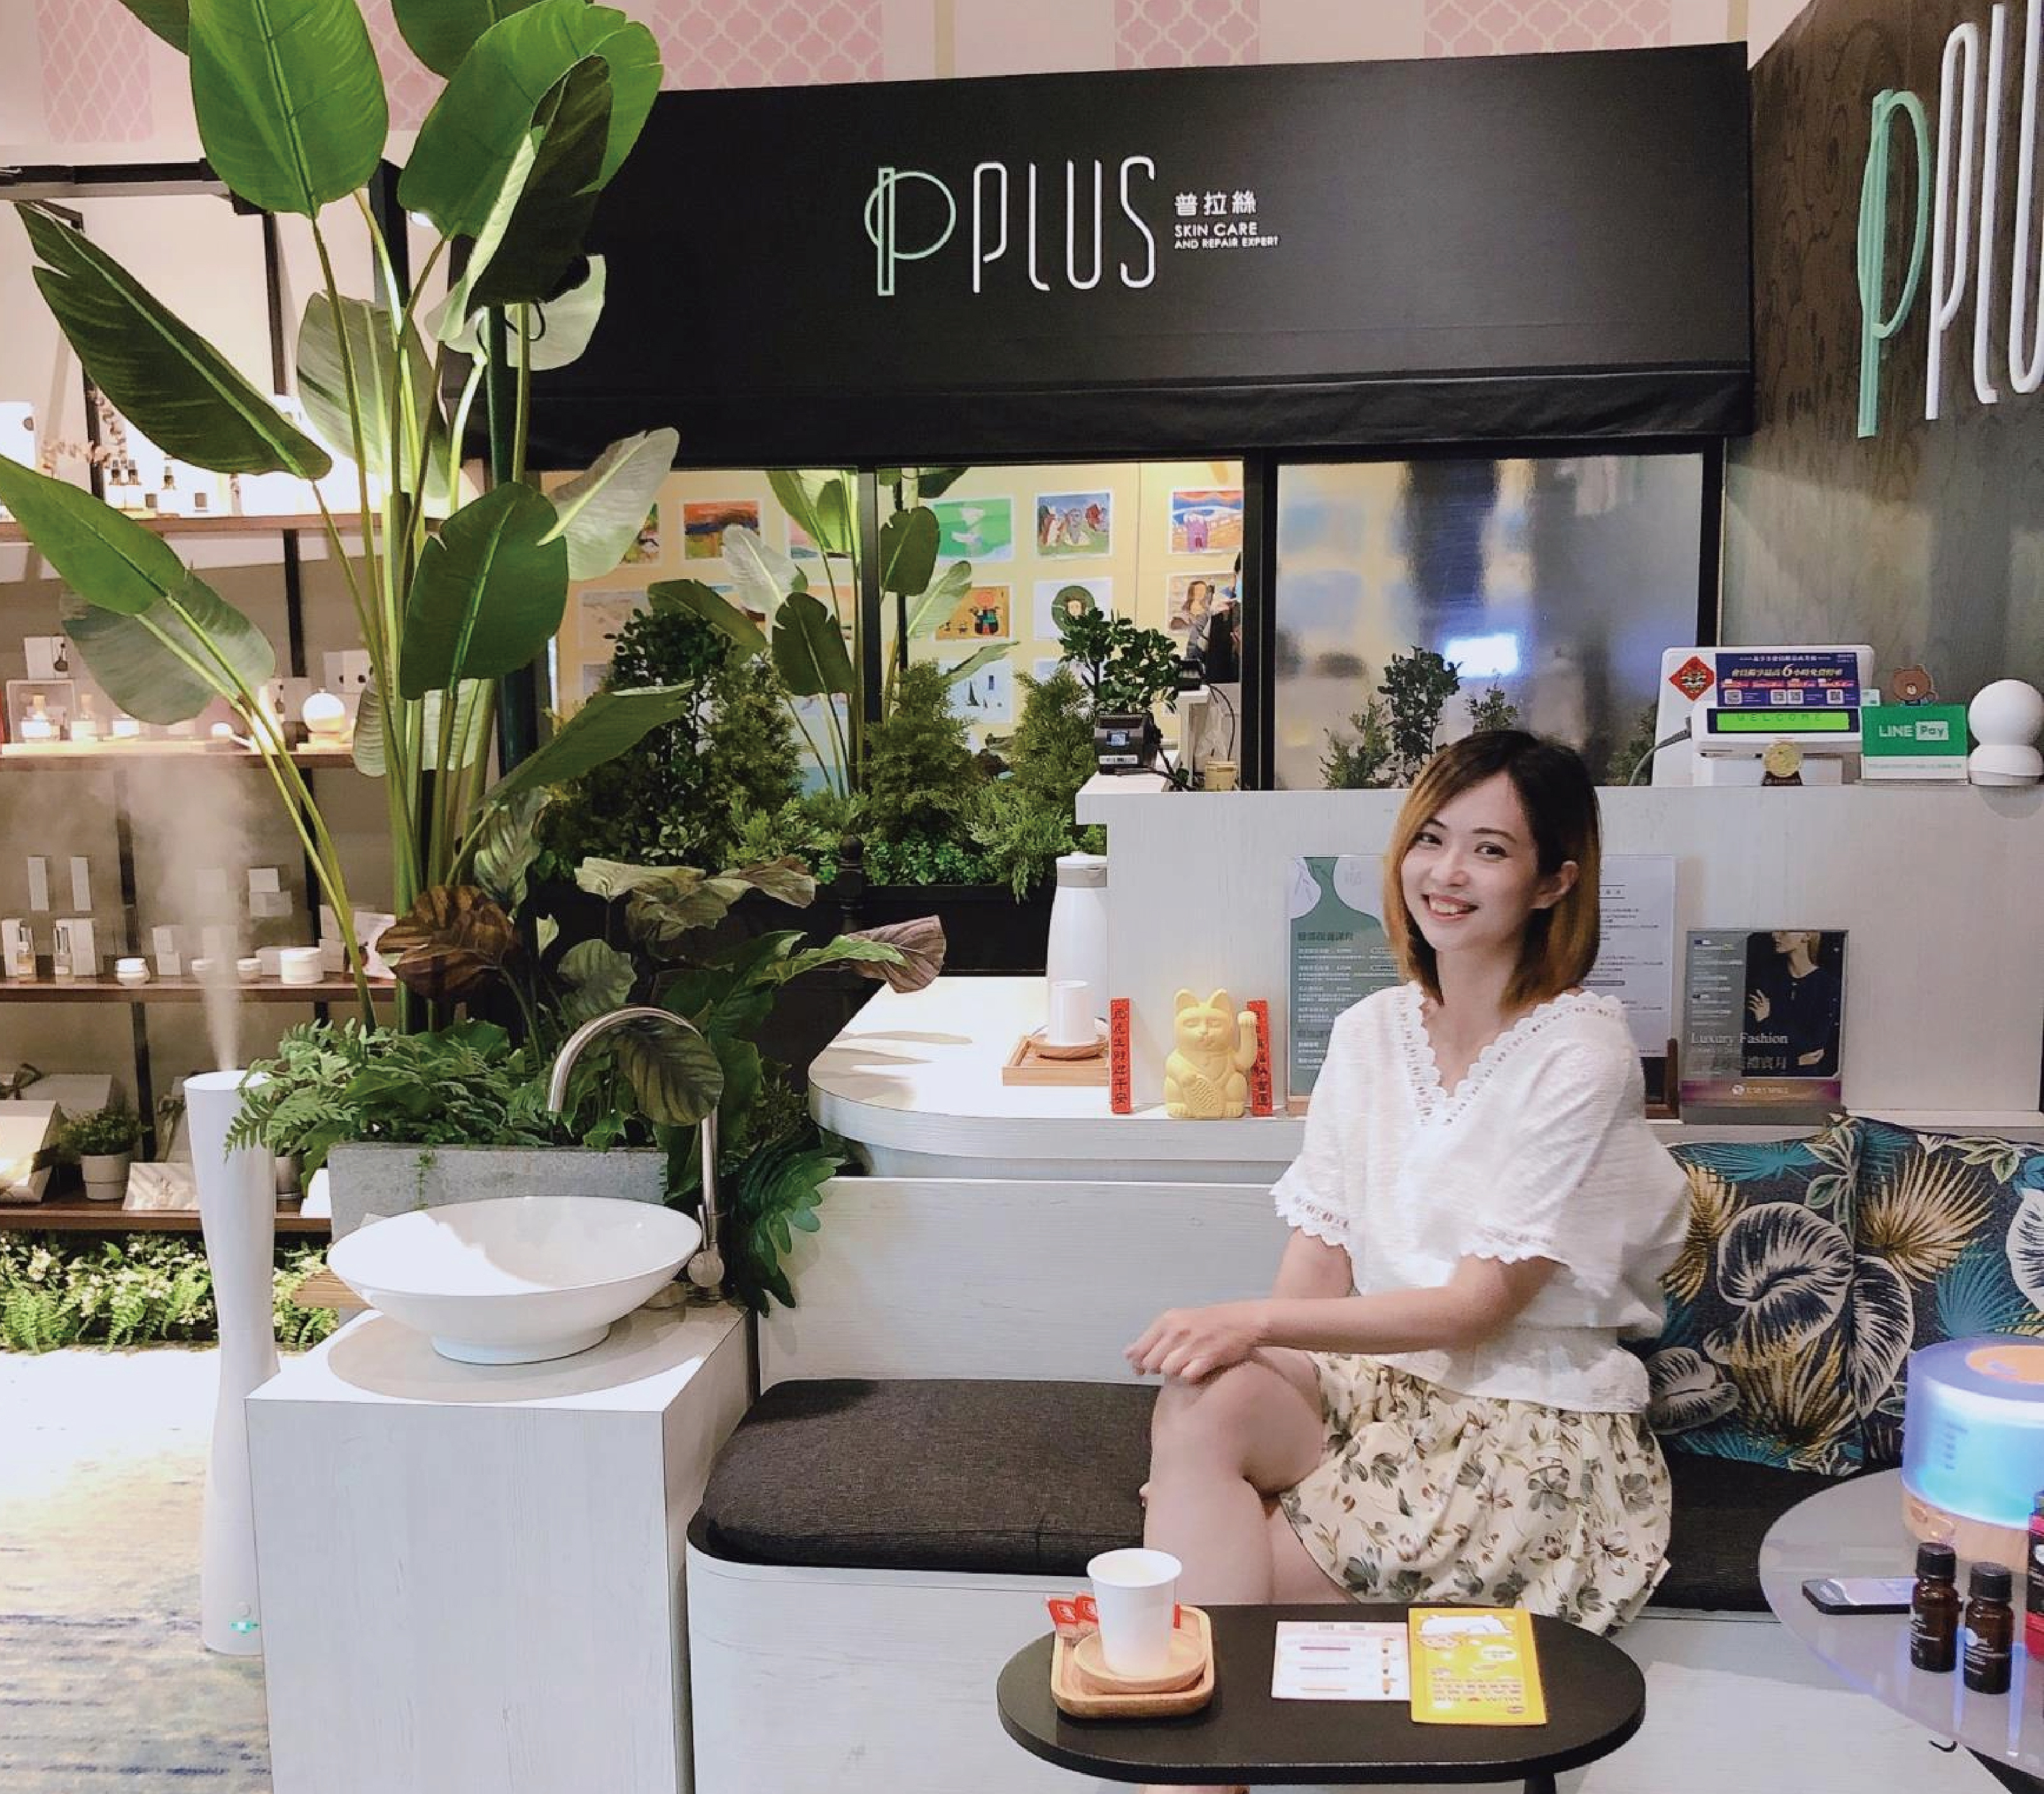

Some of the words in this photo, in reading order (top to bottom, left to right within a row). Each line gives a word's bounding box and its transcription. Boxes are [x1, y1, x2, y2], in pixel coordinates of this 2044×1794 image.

[1175, 190, 1256, 216] 普拉絲
[1175, 224, 1209, 238] SKIN
[1213, 222, 1258, 237] CARE
[1174, 240, 1199, 250] AND
[1202, 237, 1239, 248] REPAIR
[1242, 236, 1279, 247] EXPERT
[1878, 724, 1913, 737] LINE
[1920, 724, 1945, 738] Pay
[1690, 1031, 1734, 1047] Luxury
[1739, 1031, 1788, 1045] Fashion
